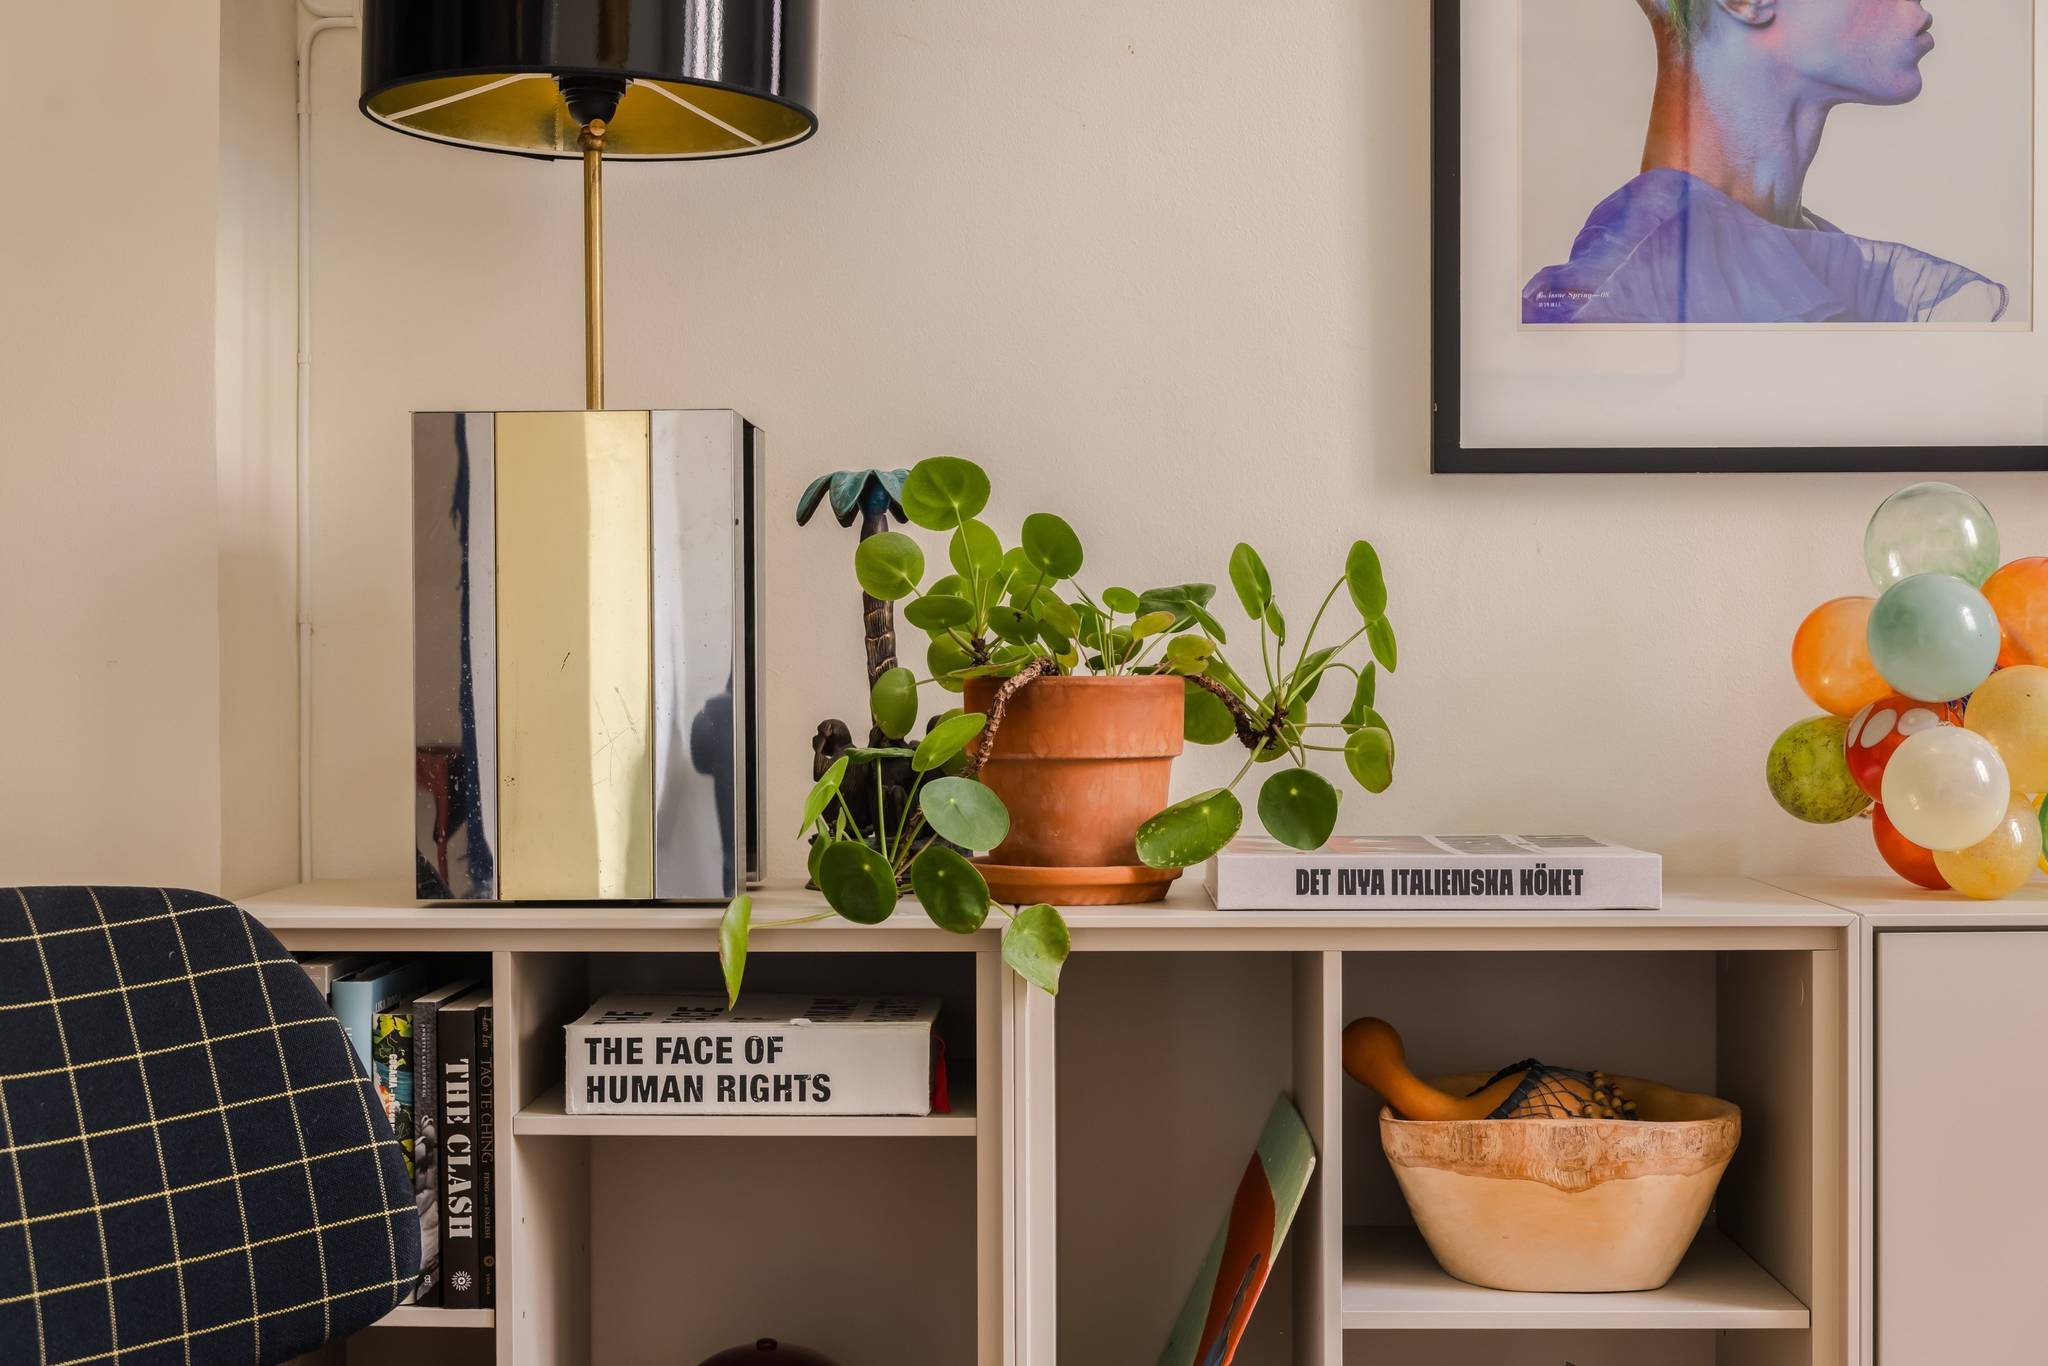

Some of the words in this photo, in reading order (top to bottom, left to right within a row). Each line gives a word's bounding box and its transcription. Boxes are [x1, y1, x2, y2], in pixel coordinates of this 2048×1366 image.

[1295, 868, 1331, 896] DET
[1338, 868, 1385, 896] NYA
[584, 1036, 643, 1065] THE
[655, 1036, 733, 1065] FACE
[744, 1035, 784, 1065] OF
[480, 1056, 493, 1088] TAO
[445, 1058, 470, 1125] THE
[480, 1089, 493, 1110] TE
[586, 1074, 704, 1104] HUMAN
[717, 1073, 832, 1103] RIGHTS
[480, 1112, 494, 1164] CHING
[446, 1133, 473, 1239] CLASH
